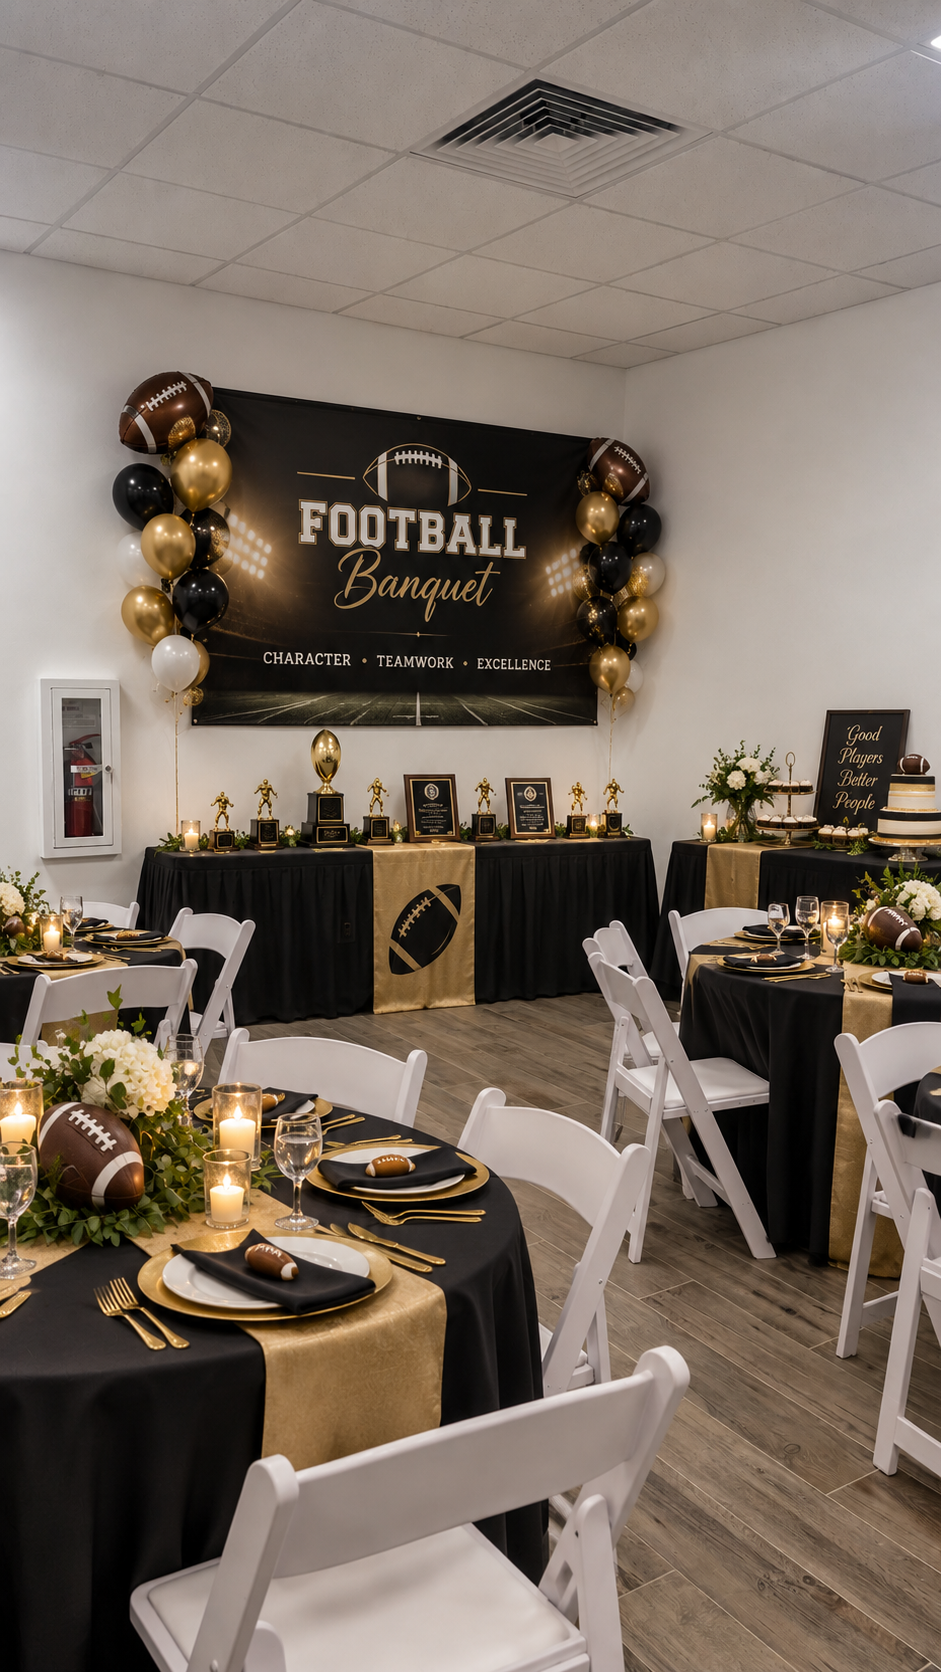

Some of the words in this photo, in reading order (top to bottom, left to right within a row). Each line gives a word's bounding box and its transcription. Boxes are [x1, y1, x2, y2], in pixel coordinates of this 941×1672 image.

[298, 498, 527, 560] FOOTBALL
[333, 547, 501, 623] Banquet
[263, 651, 351, 666] CHARACTER
[376, 654, 454, 669] TEAMWORK
[477, 657, 551, 671] EXCELLENCE
[846, 724, 883, 746] Good
[837, 747, 883, 769] Players
[837, 768, 878, 787] Better
[832, 790, 876, 815] People
